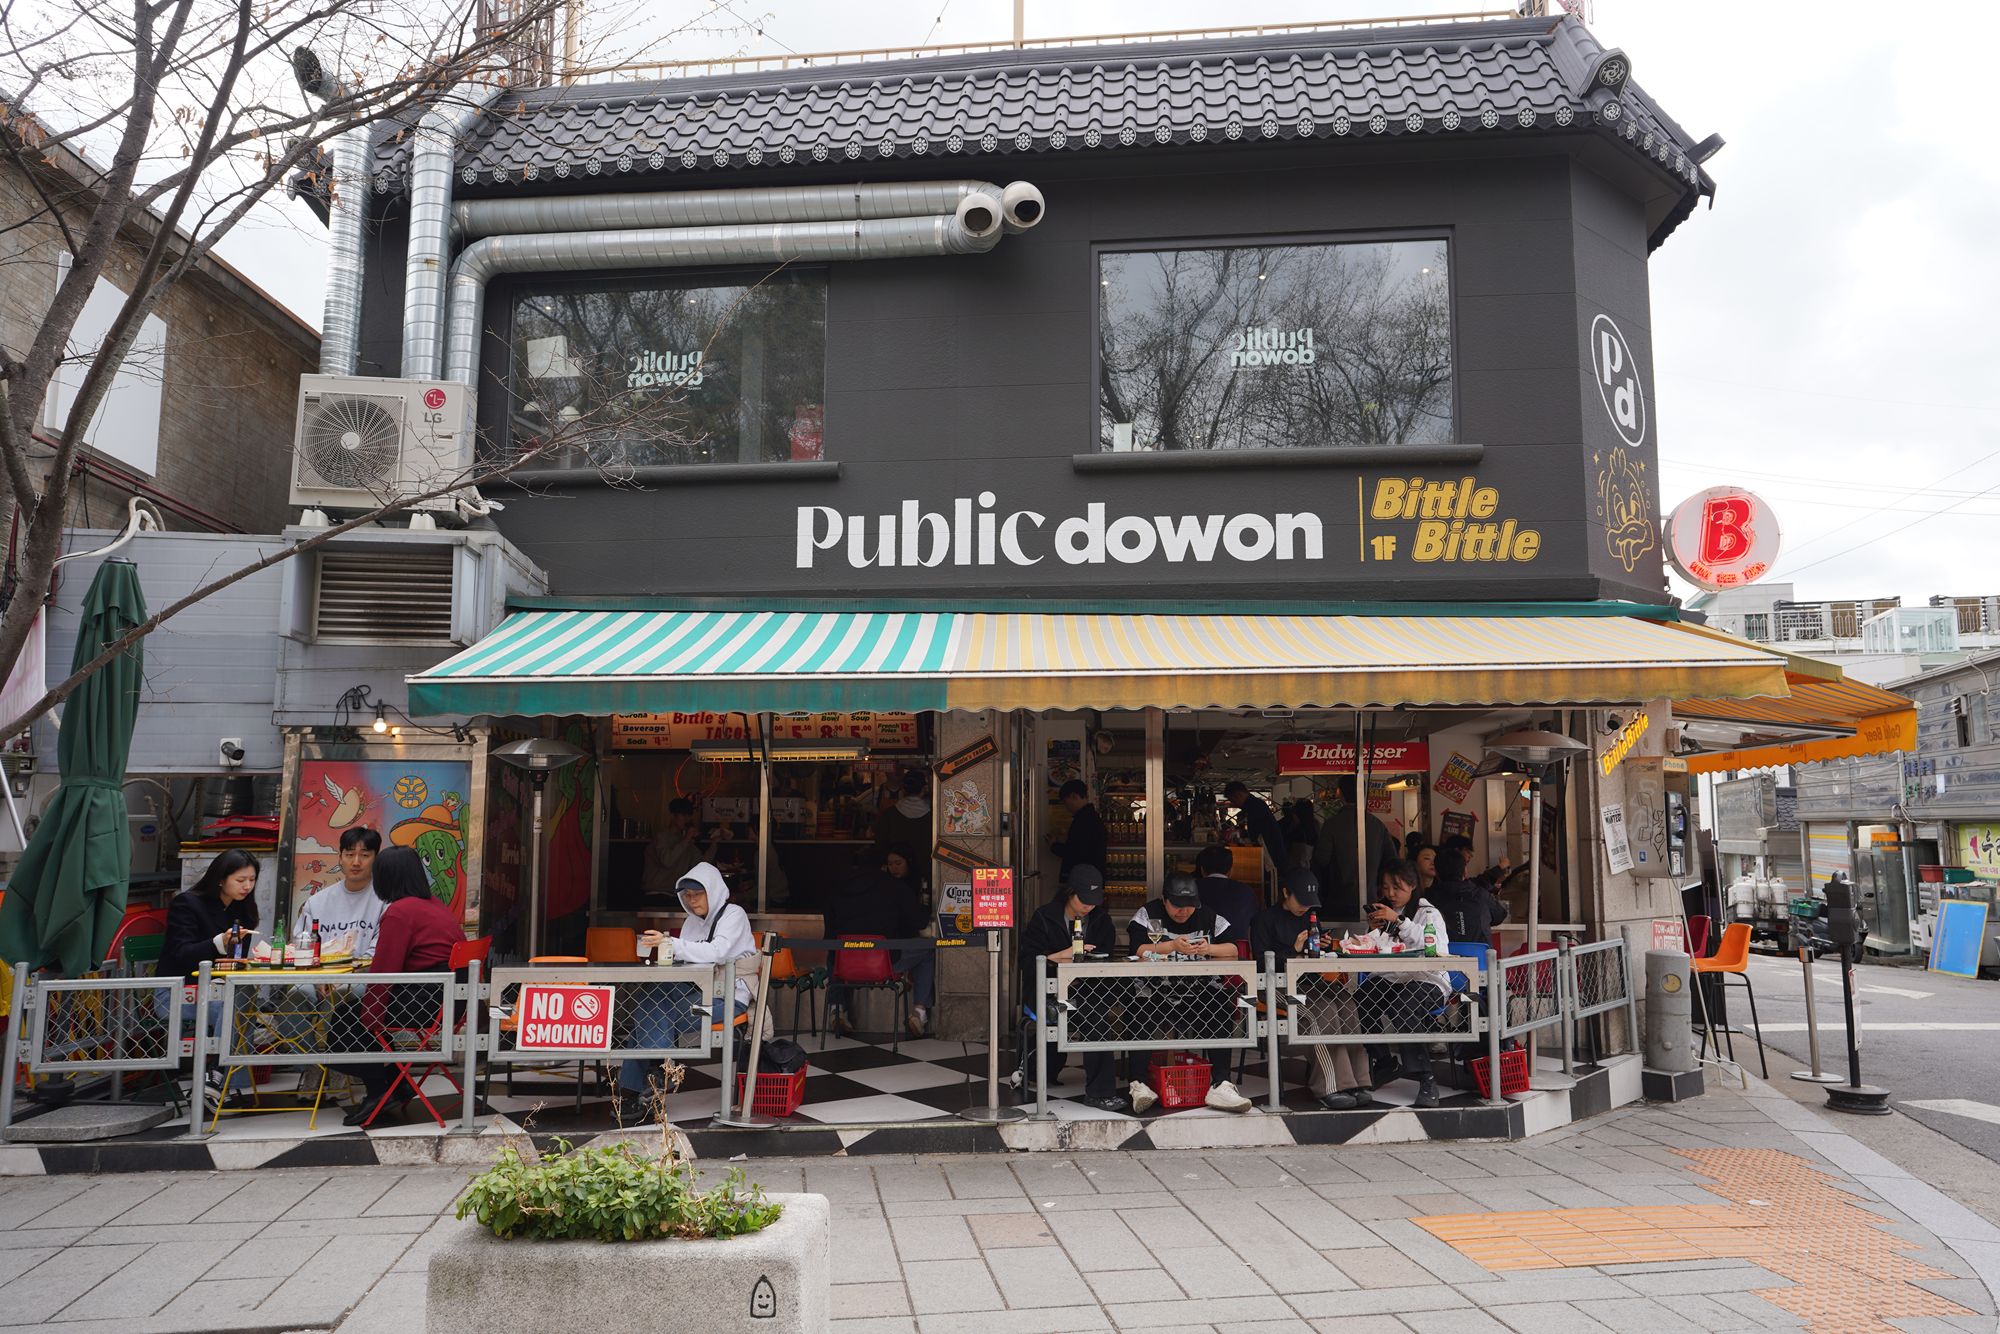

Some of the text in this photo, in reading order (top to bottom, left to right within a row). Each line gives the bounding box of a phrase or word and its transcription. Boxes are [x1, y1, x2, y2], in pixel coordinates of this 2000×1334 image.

[424, 412, 442, 423] LG
[1371, 477, 1499, 519] Bittle
[796, 491, 1323, 568] Public dowon
[1699, 495, 1757, 567] B
[1370, 519, 1541, 562] 1F Bittle
[622, 725, 666, 733] Beverage
[1663, 760, 1685, 769] Phone
[976, 868, 1010, 880] 입구 X
[946, 886, 971, 900] Coro
[320, 920, 374, 933] NAUTICA
[531, 992, 564, 1020] NO
[525, 1023, 604, 1044] SMOKING
